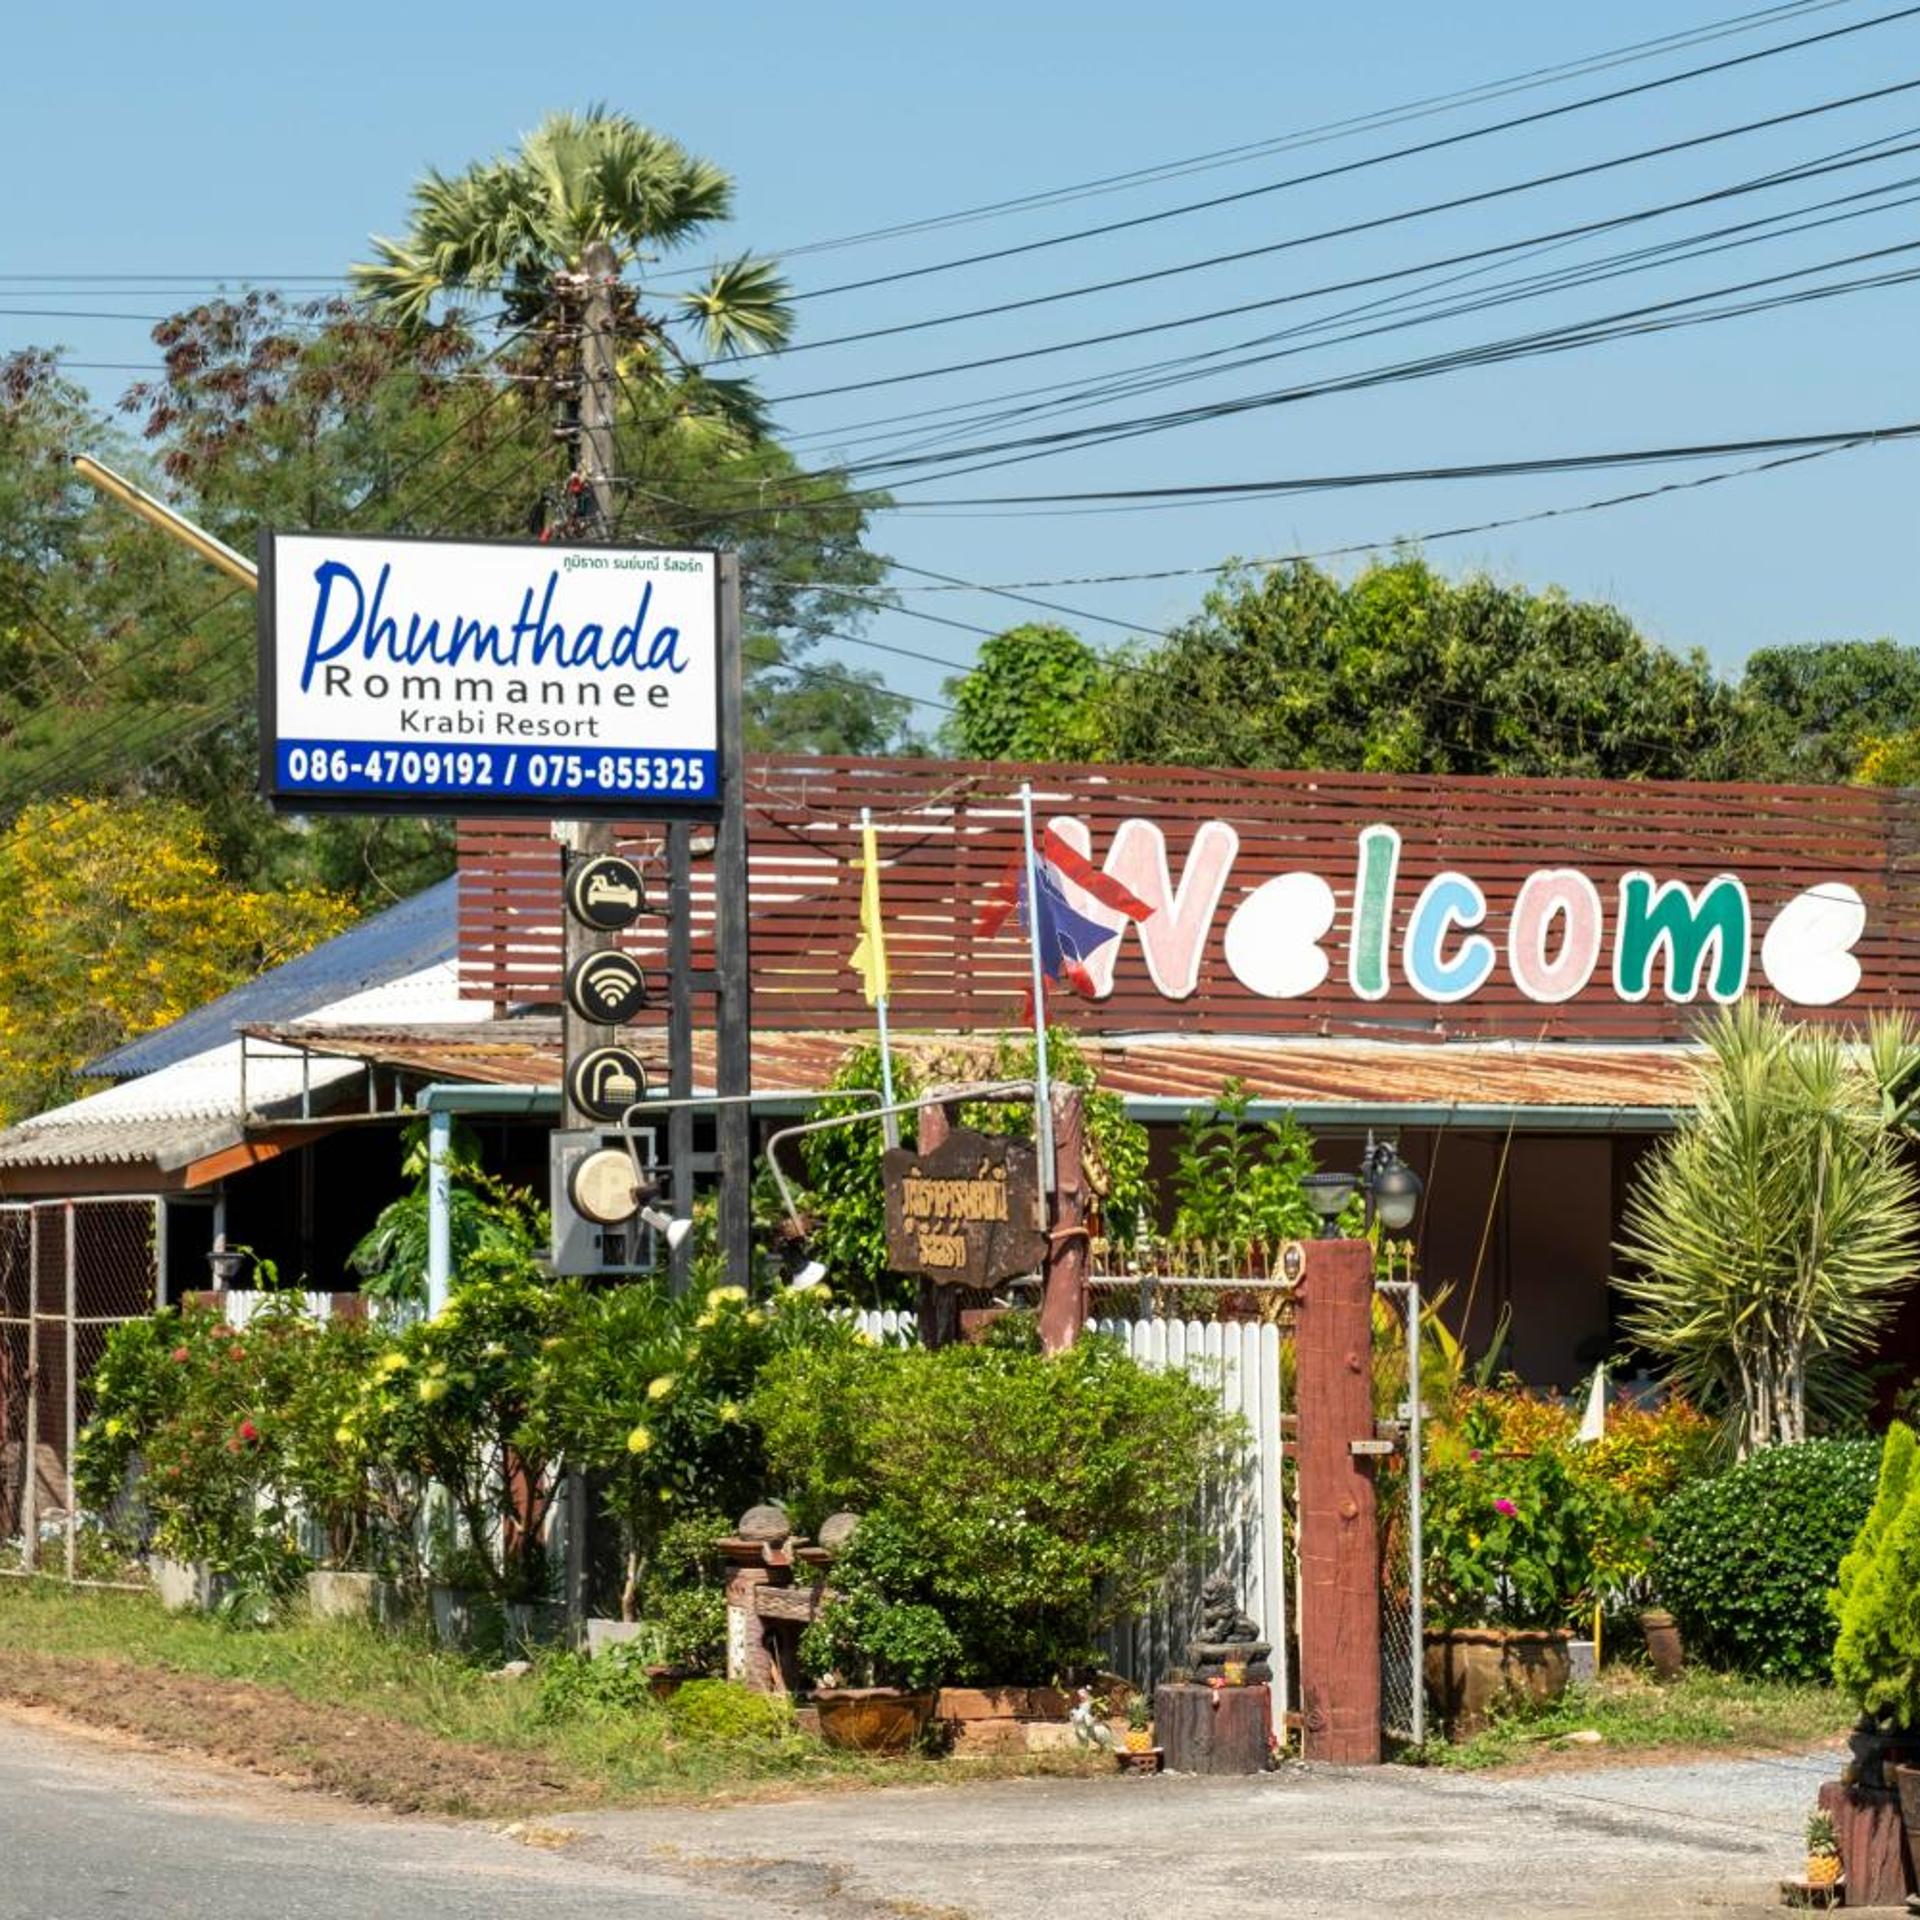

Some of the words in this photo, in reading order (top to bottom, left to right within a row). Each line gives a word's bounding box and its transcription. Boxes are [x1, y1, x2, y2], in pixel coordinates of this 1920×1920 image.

[300, 559, 691, 693] Phumthada
[325, 664, 670, 708] Rommannee
[400, 709, 485, 734] Krabi
[496, 712, 600, 738] Resort
[289, 748, 493, 785] 086-4709192
[503, 754, 518, 786] /
[528, 754, 704, 790] 075-855325
[1044, 816, 1867, 1006] Welcome
